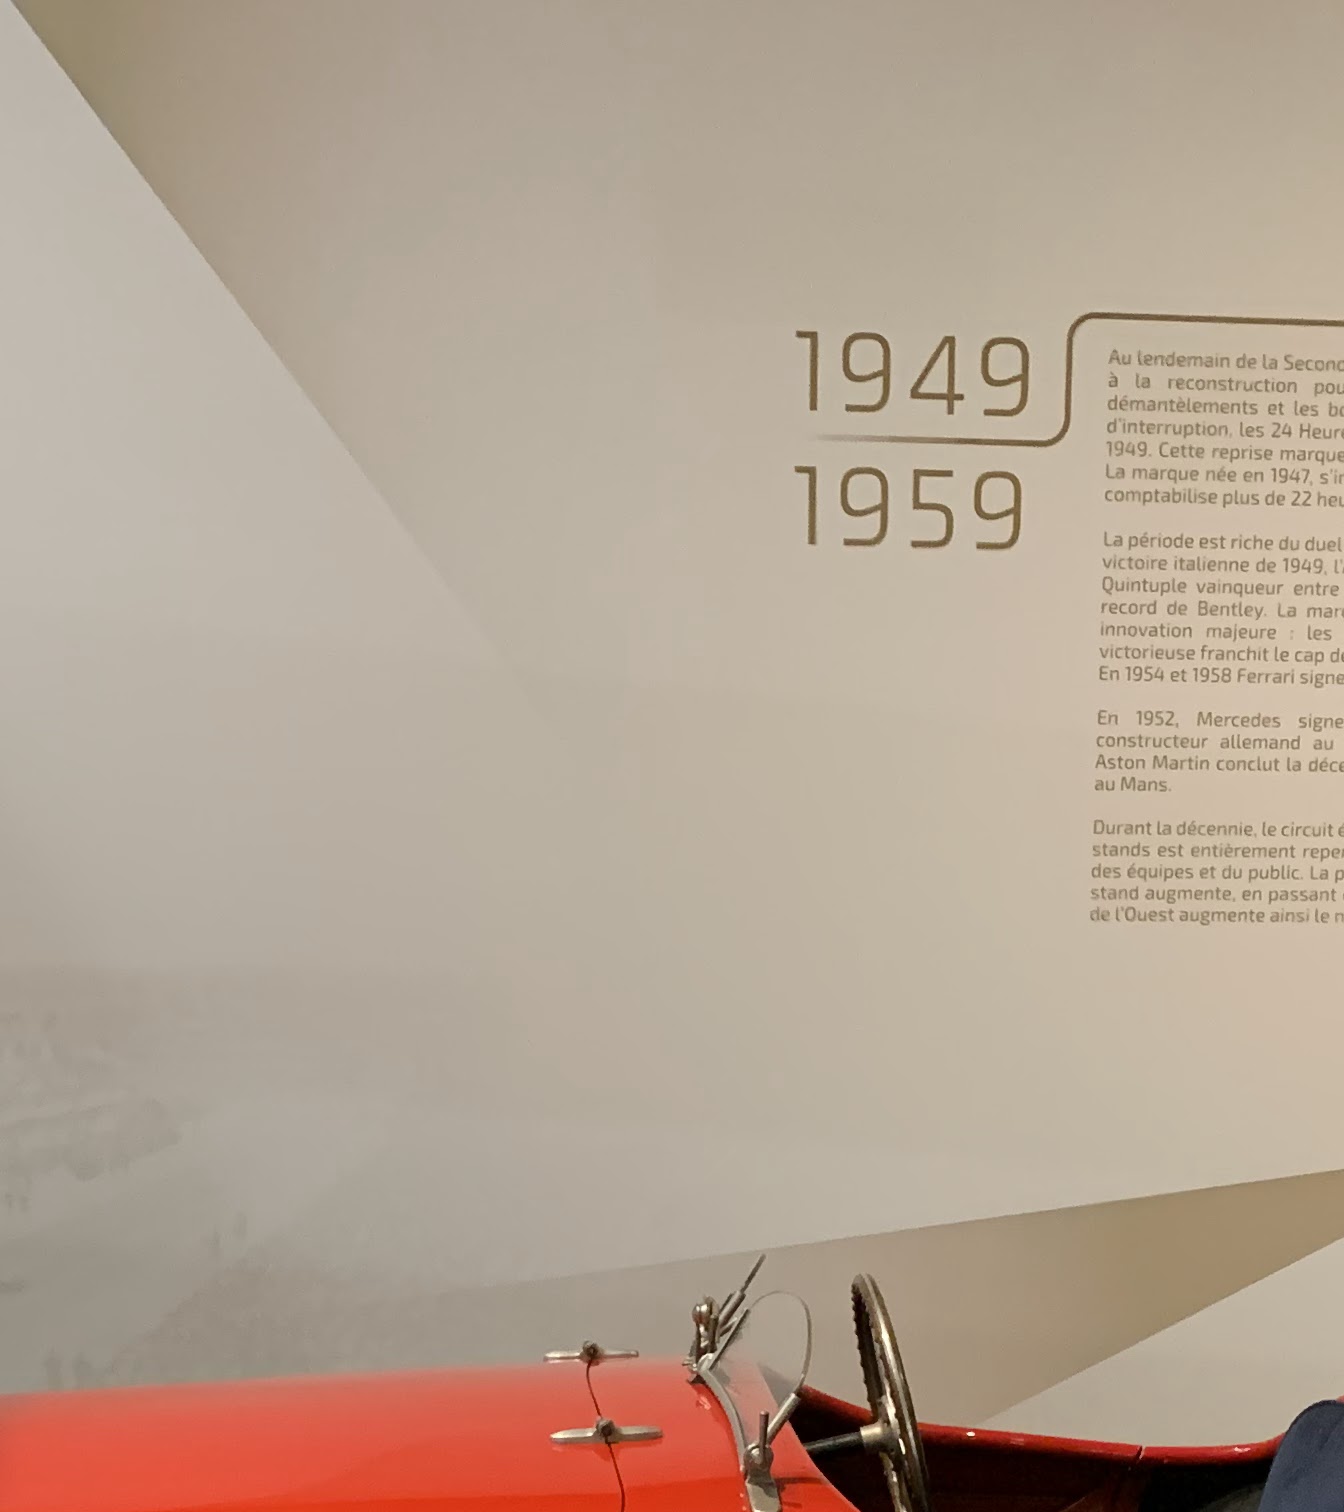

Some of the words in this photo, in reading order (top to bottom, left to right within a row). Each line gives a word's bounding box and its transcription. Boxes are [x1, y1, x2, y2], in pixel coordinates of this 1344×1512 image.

[1107, 349, 1132, 366] Au
[1136, 349, 1230, 368] lendemain
[1235, 352, 1257, 369] de
[1261, 353, 1278, 370] la
[796, 331, 1029, 417] 1949
[1106, 394, 1258, 415] démantèlements
[1266, 400, 1285, 415] et
[1293, 399, 1319, 417] les
[1238, 421, 1265, 438] les
[1270, 421, 1293, 438] 24
[1105, 440, 1152, 457] 1949.
[1157, 441, 1205, 459] Cette
[1211, 443, 1273, 464] reprise
[795, 466, 1022, 550] 1959
[1104, 486, 1218, 507] comptabilise
[1221, 489, 1260, 509] plus
[1264, 489, 1286, 506] de
[1290, 490, 1312, 506] 22
[1101, 554, 1168, 571] victoire
[1172, 555, 1250, 572] italienne
[1254, 557, 1277, 573] de
[1281, 557, 1327, 575] 1949,
[1100, 598, 1157, 615] record
[1165, 599, 1188, 616] de
[1197, 600, 1267, 620] Bentley.
[1276, 602, 1297, 618] La
[1098, 665, 1120, 681] En
[1124, 665, 1164, 682] 1954
[1169, 668, 1187, 682] et
[1191, 666, 1232, 683] 1958
[1236, 667, 1295, 684] Ferrari
[1096, 709, 1118, 725] En
[1135, 709, 1179, 728] 1952,
[1196, 711, 1281, 728] Mercedes
[1297, 713, 1344, 732] signe
[1095, 733, 1208, 749] constructeur
[1219, 733, 1301, 750] allemand
[1312, 738, 1334, 750] au
[1093, 779, 1115, 791] au
[1119, 776, 1171, 792] Mans.
[1091, 841, 1151, 857] stands
[1156, 843, 1184, 857] est
[1189, 842, 1296, 858] entièrement
